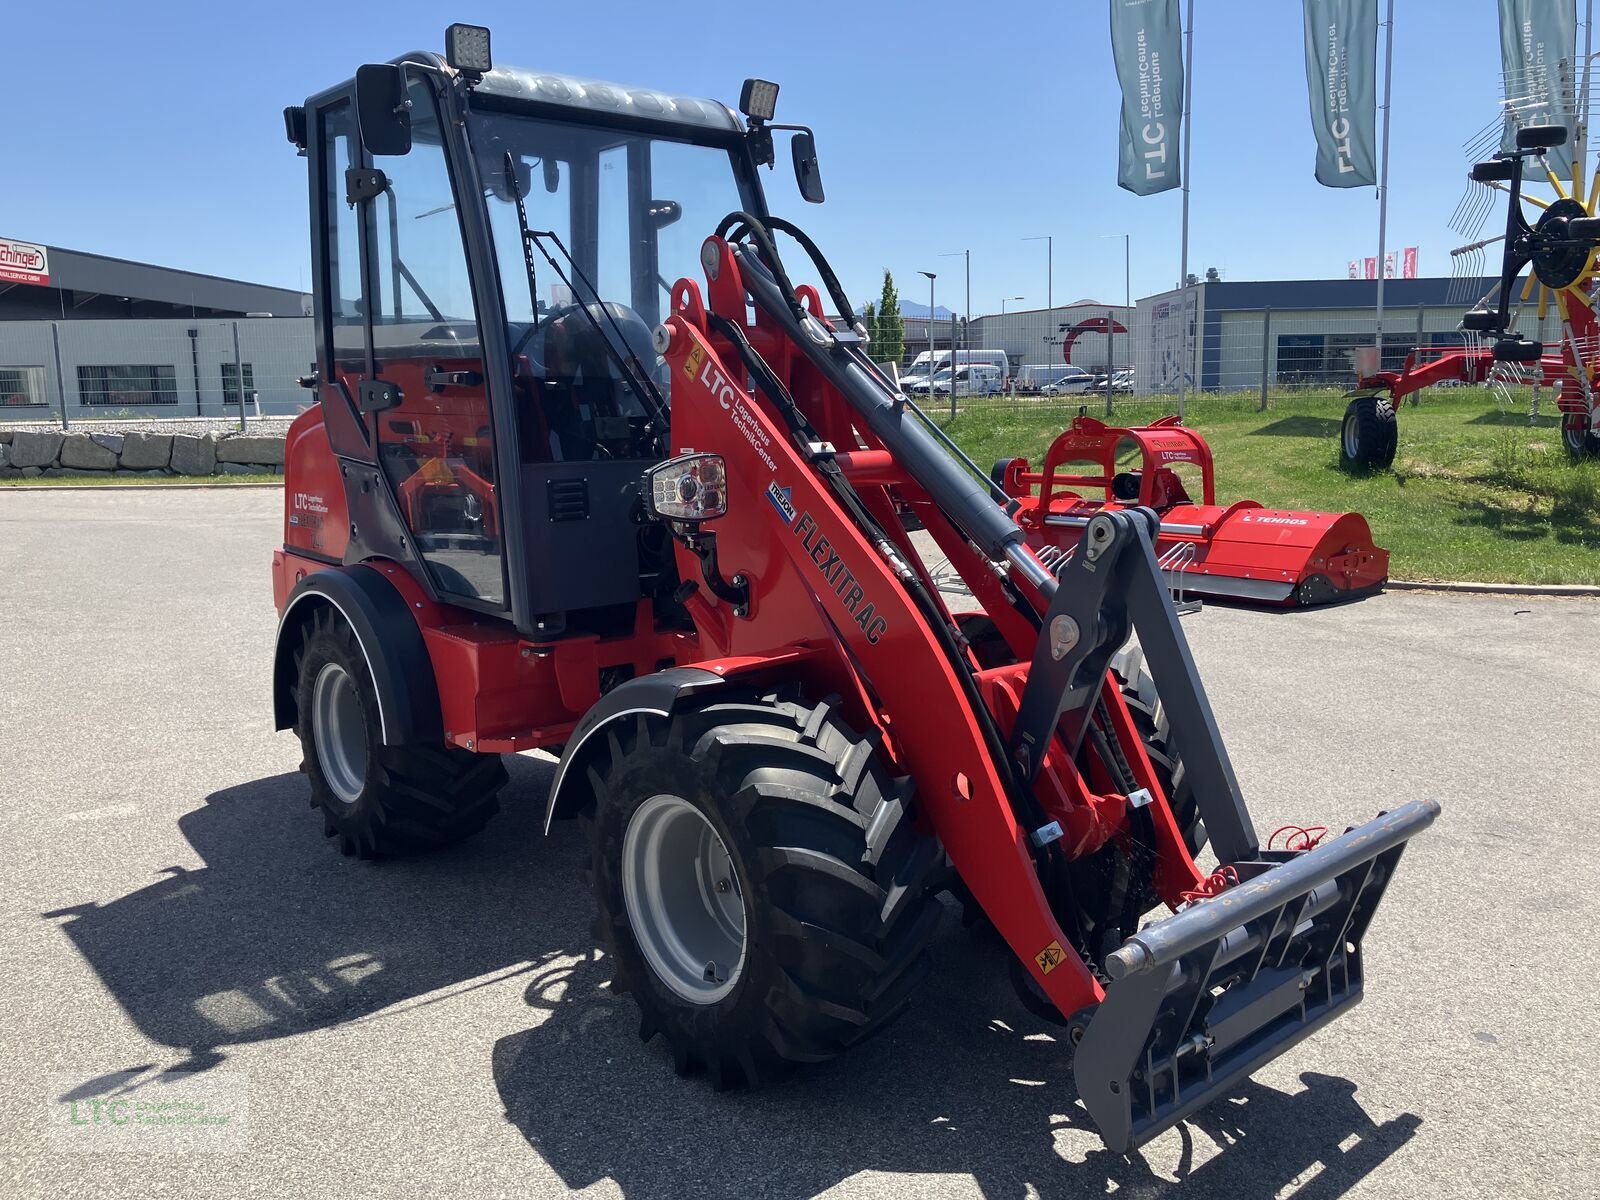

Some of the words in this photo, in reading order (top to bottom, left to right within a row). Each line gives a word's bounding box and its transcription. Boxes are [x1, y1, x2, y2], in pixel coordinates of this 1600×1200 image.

[700, 360, 735, 410] LTC
[730, 408, 778, 472] TechnikCenter
[735, 398, 771, 447] Lagerhaus
[1161, 451, 1174, 460] LTC
[294, 492, 308, 510] LTC
[770, 481, 796, 519] TREJON
[793, 511, 887, 646] FLEXITRAC
